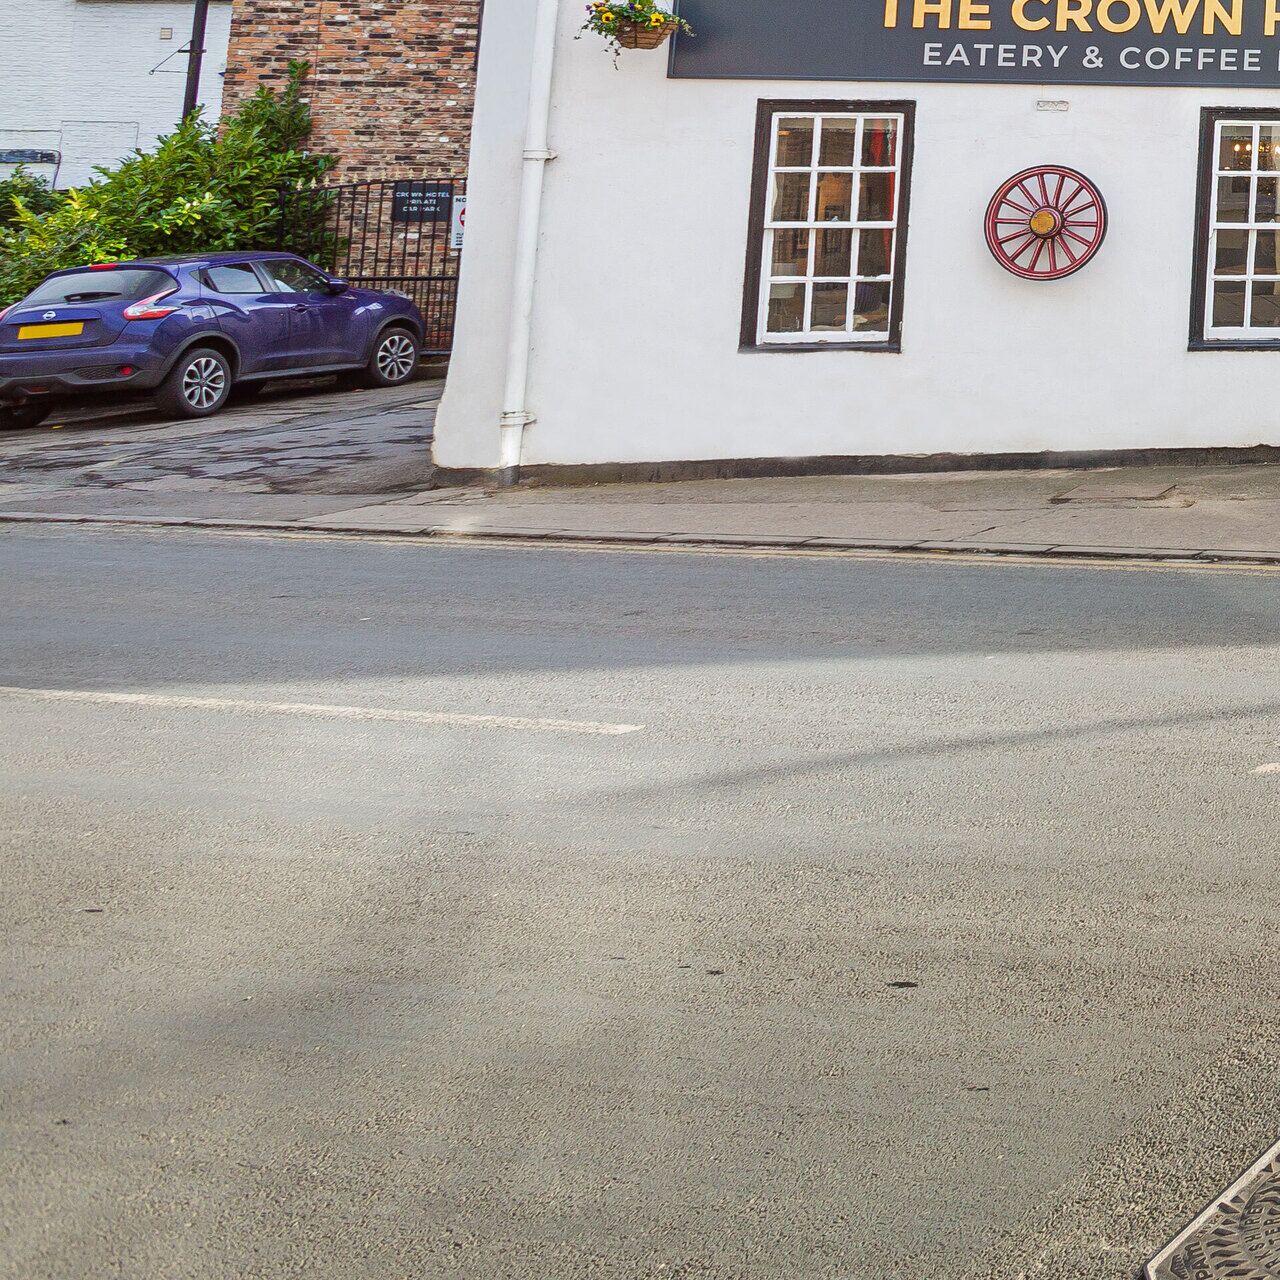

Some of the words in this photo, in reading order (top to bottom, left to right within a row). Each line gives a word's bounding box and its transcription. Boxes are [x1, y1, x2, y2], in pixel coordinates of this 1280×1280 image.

[923, 42, 1068, 68] EATERY
[1081, 45, 1103, 69] &
[1119, 47, 1261, 71] COFFEE
